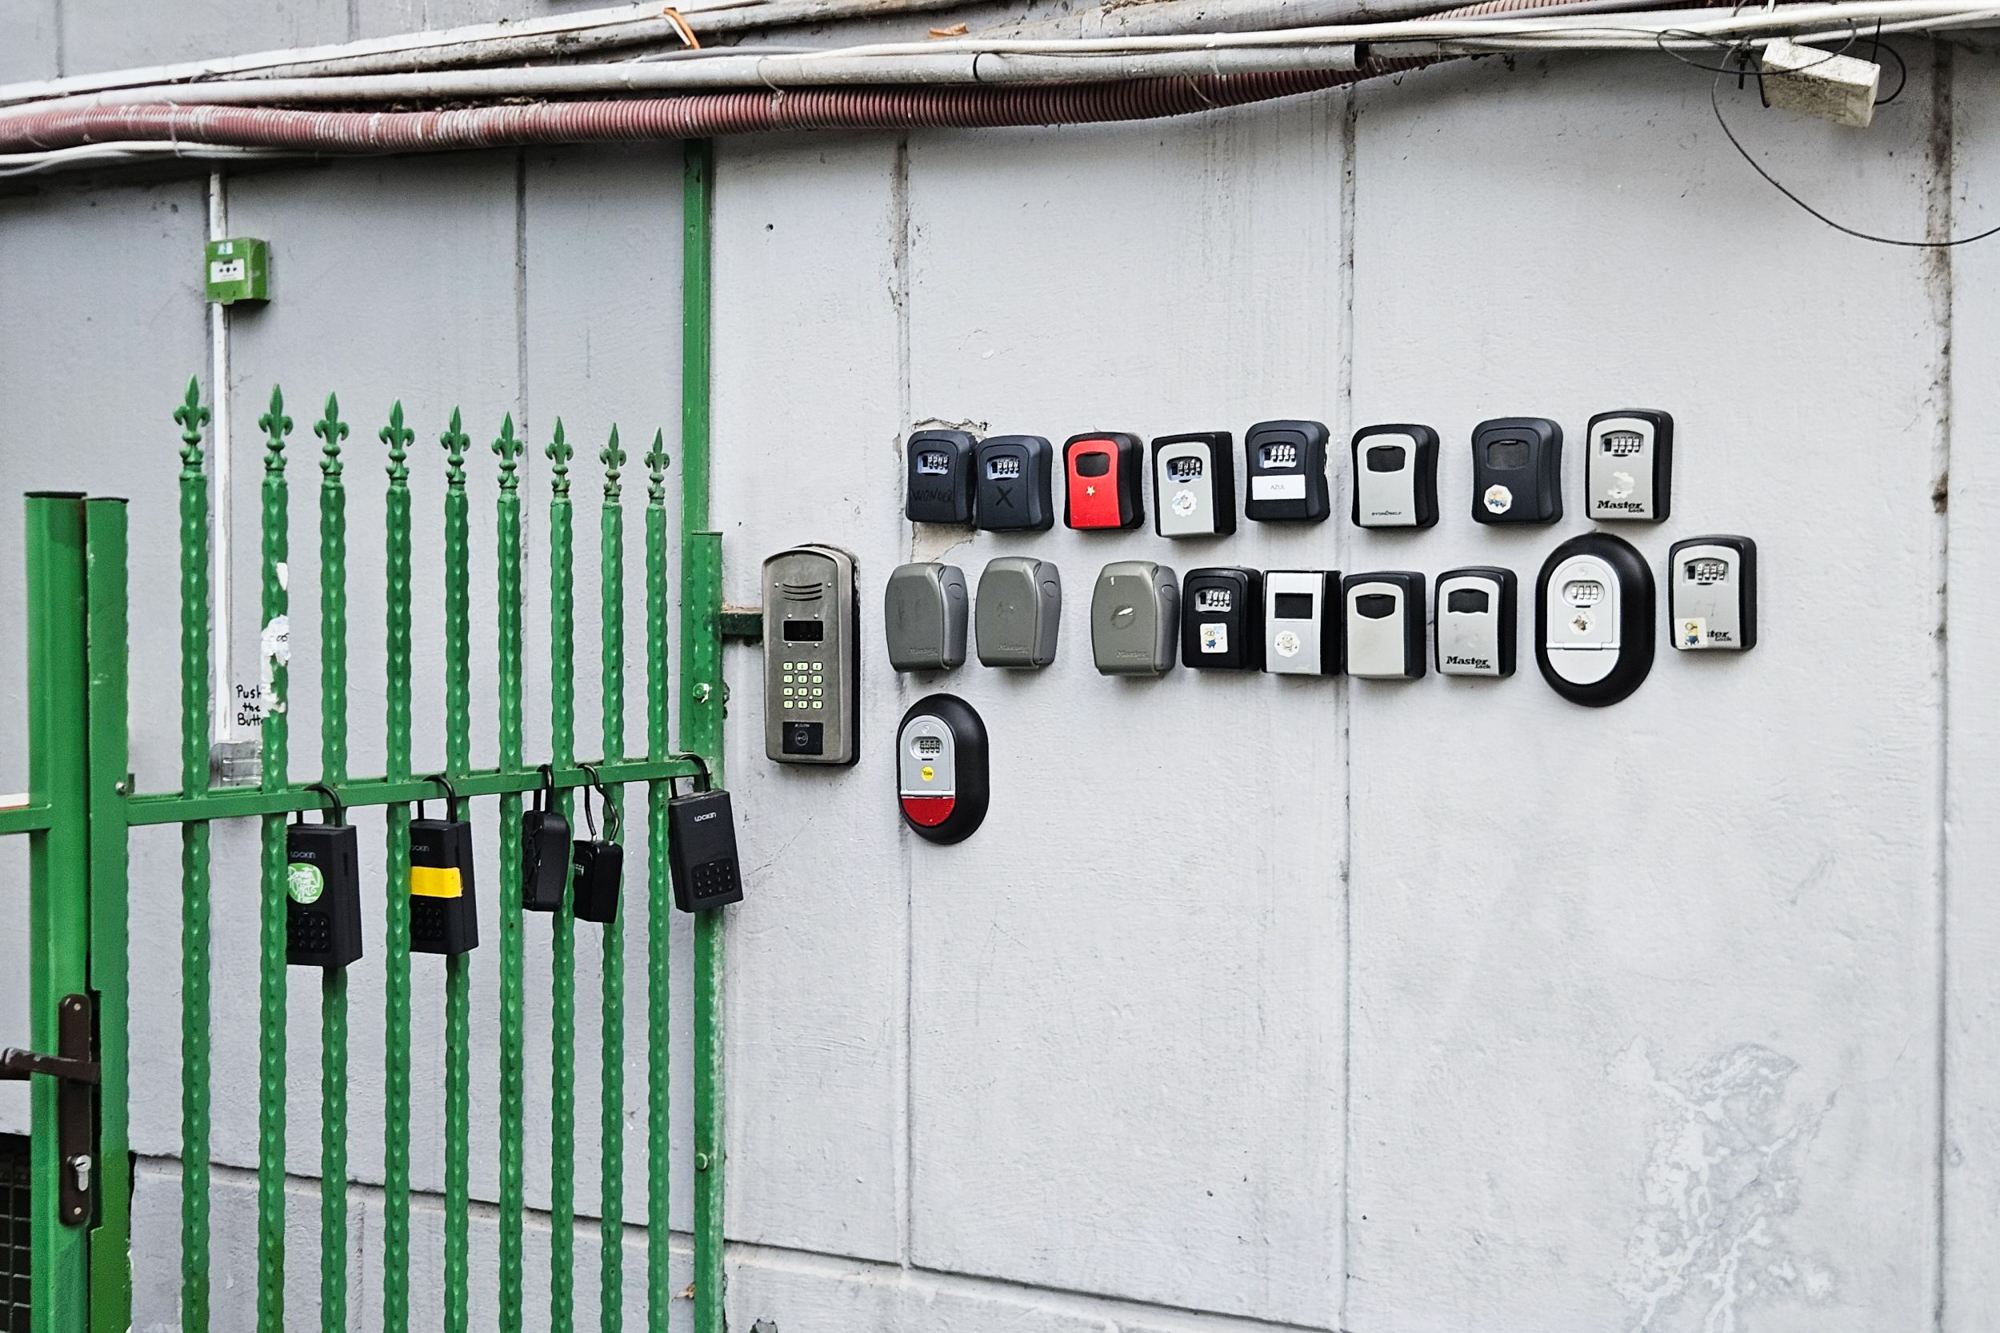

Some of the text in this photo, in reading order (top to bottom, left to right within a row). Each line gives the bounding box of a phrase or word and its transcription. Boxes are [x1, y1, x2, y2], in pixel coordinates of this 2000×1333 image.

[1597, 500, 1642, 509] Master
[1446, 656, 1488, 665] Master
[236, 685, 261, 699] Push
[243, 702, 261, 712] the
[237, 712, 262, 726] Butt
